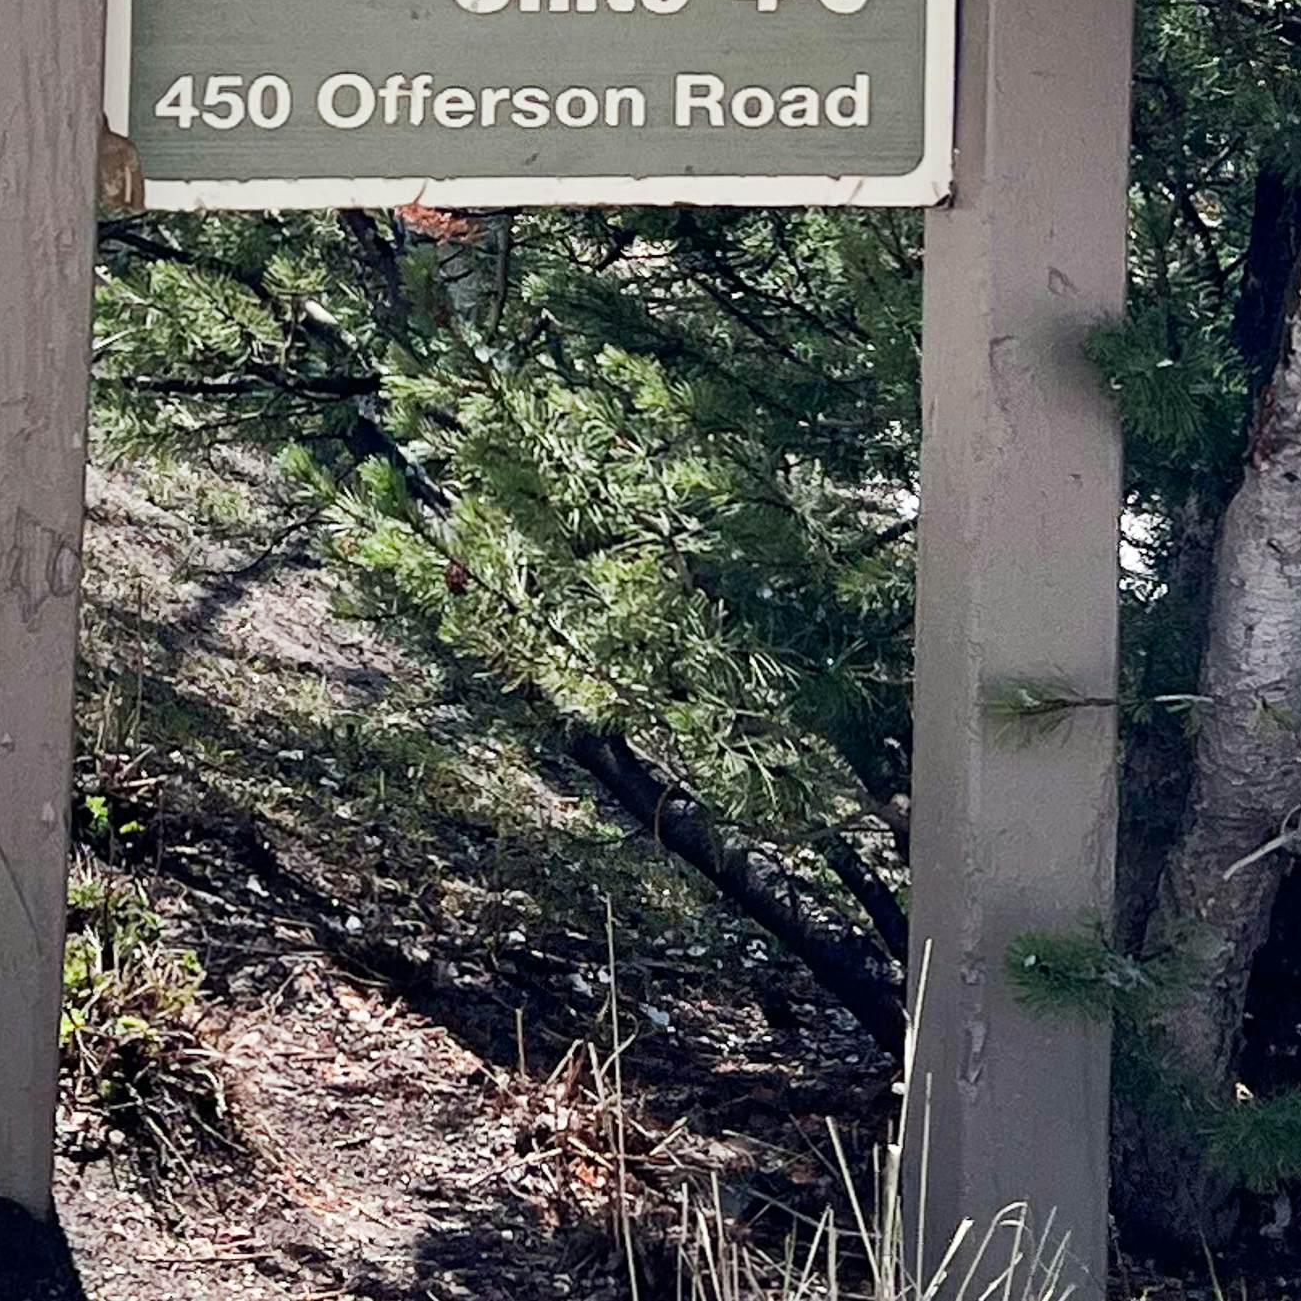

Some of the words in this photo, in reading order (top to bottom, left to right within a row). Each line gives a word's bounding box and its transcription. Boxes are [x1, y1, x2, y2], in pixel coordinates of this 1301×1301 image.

[154, 74, 293, 131] 450
[316, 71, 646, 131] Offerson
[674, 73, 871, 129] Road
